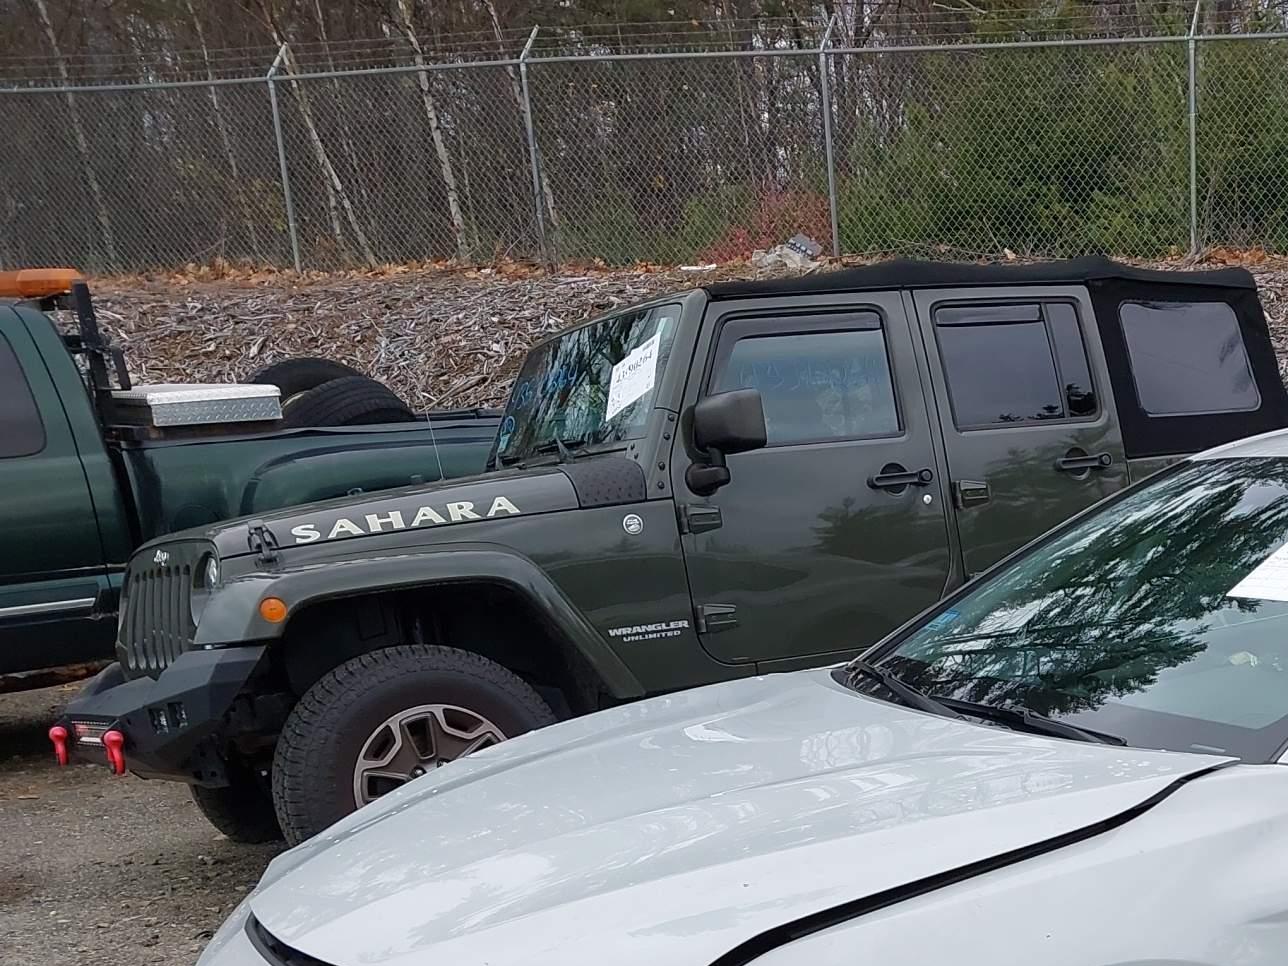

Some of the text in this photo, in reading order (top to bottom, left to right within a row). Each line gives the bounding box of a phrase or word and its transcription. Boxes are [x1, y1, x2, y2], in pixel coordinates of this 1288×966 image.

[291, 496, 521, 544] SAHARA
[608, 620, 689, 637] WRANGLER
[622, 630, 681, 642] UNLIMITED
